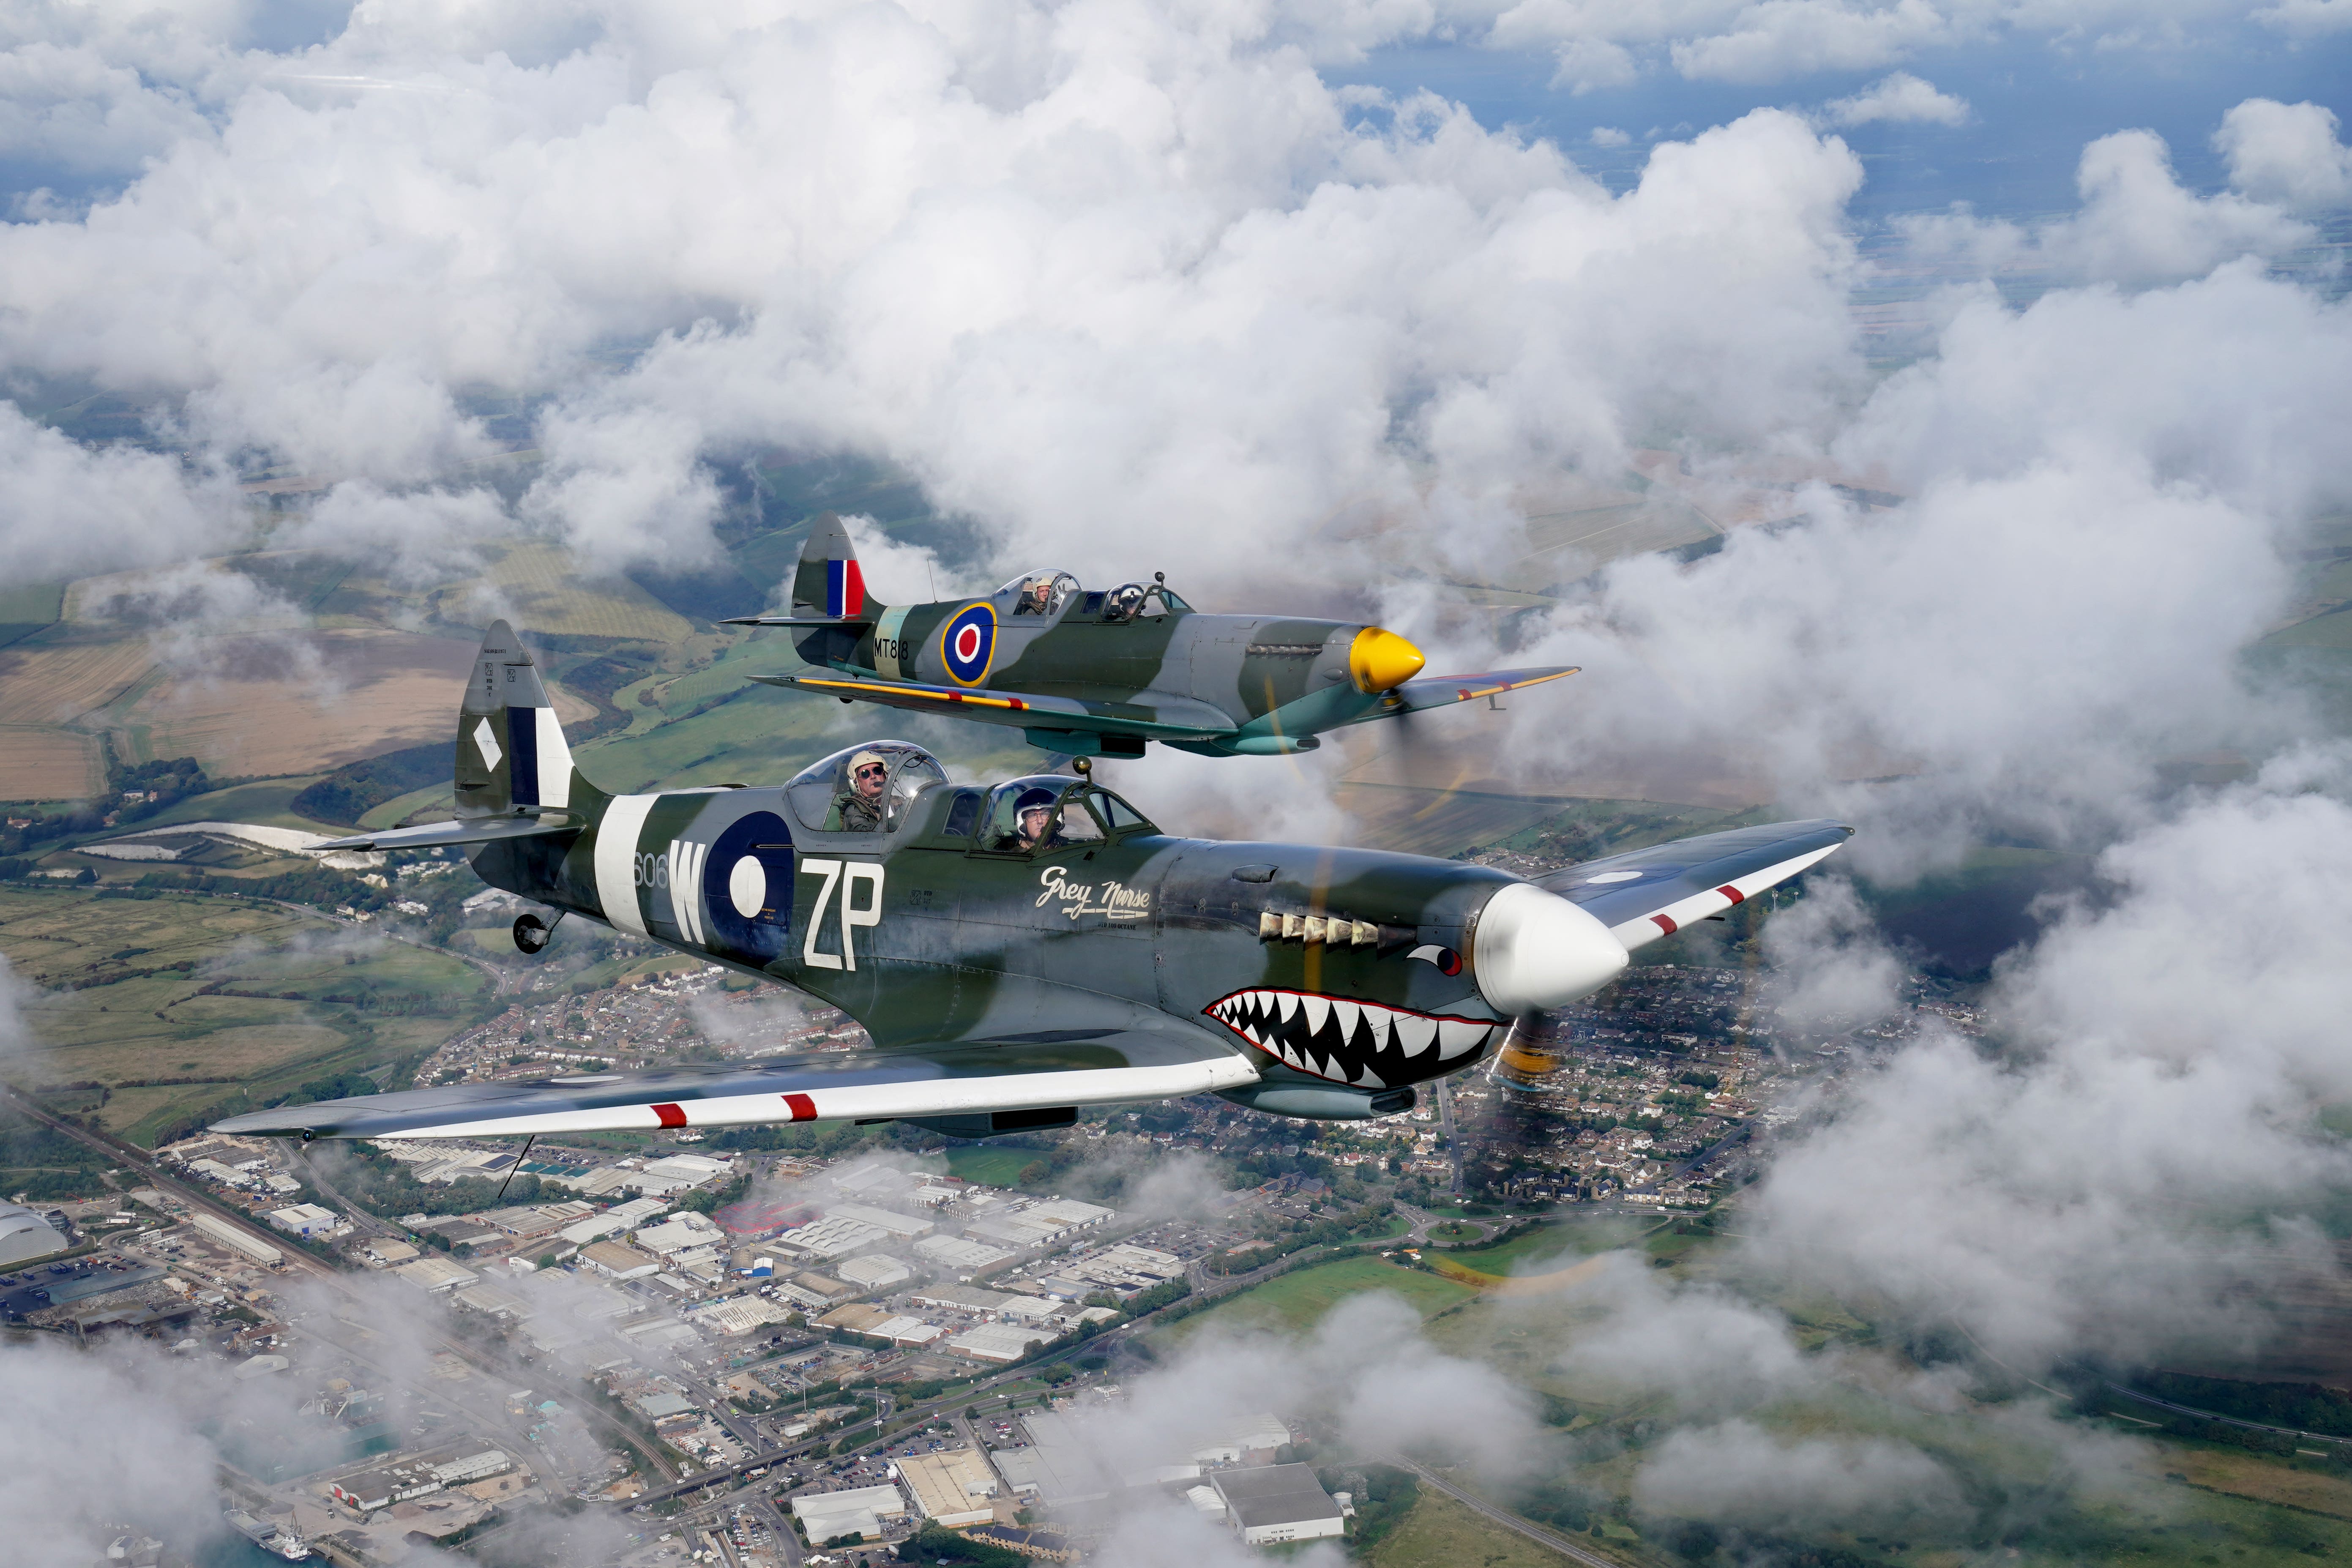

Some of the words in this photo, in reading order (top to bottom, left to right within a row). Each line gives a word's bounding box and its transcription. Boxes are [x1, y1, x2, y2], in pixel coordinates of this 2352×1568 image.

[874, 638, 908, 660] MT818
[634, 852, 668, 889] 606
[669, 839, 706, 945] W
[1036, 866, 1092, 920] Grey
[1101, 881, 1150, 919] Nurse
[800, 858, 885, 972] ZP
